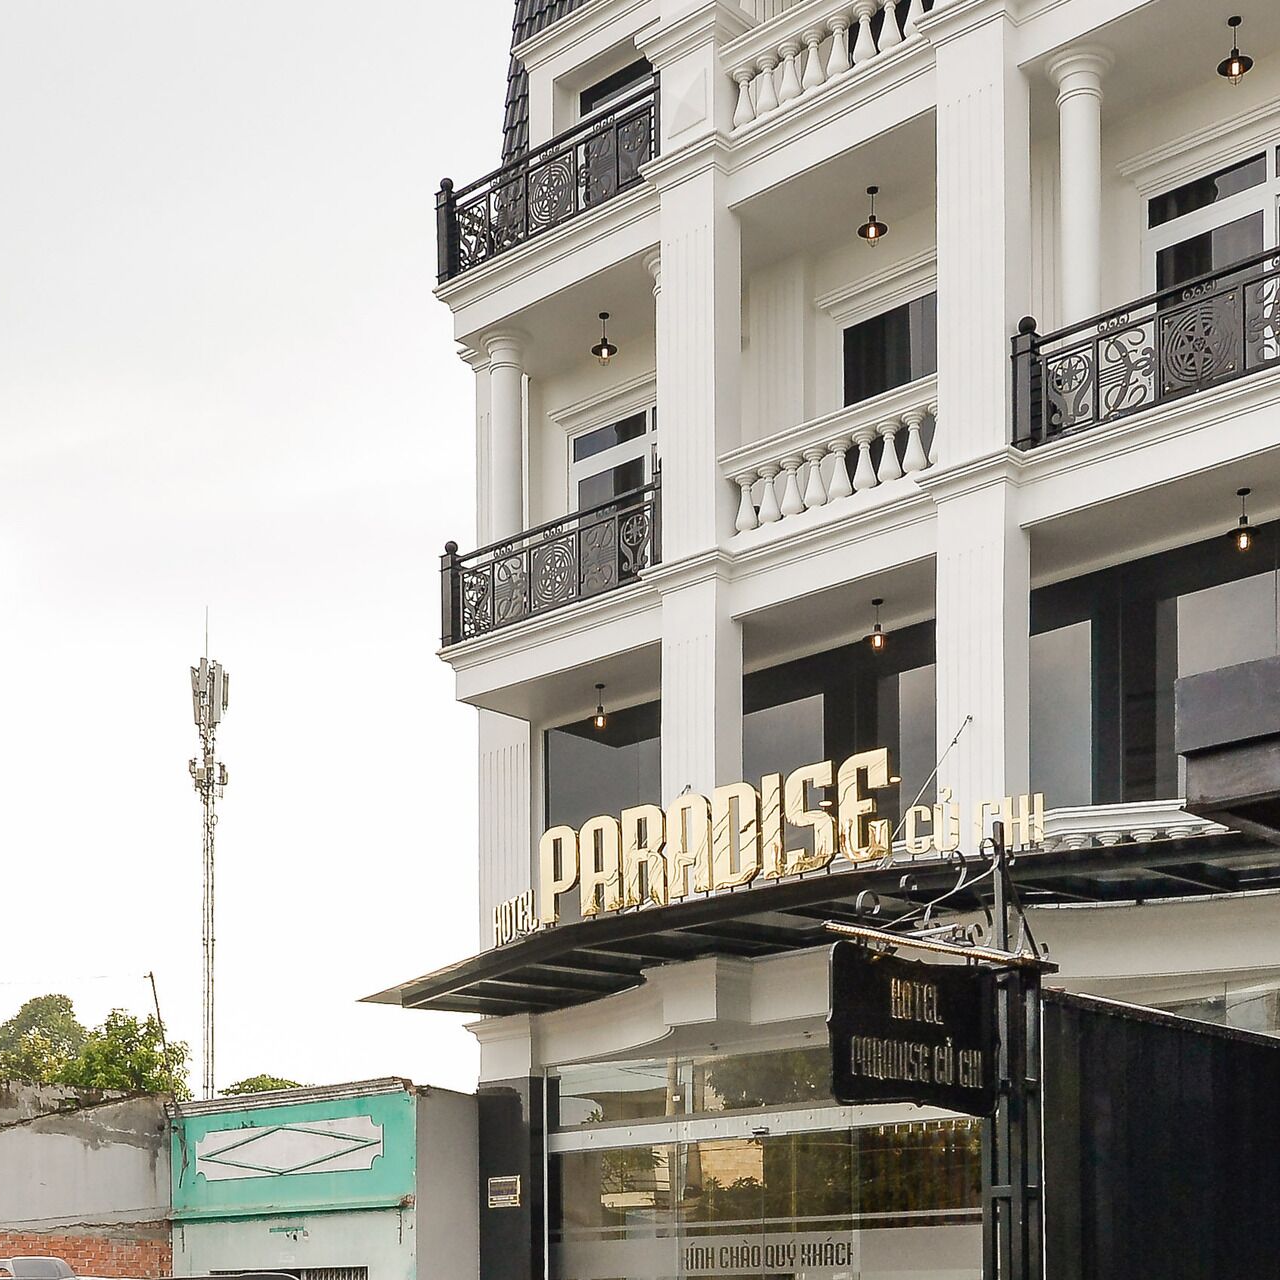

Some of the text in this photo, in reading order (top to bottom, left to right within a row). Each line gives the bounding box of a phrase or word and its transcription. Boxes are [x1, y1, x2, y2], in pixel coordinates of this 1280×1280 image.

[492, 747, 1045, 948] HOTEL PARADISE CỦ CHI
[891, 977, 944, 1025] HOTEL
[851, 1035, 930, 1083] PARADISE
[959, 1049, 984, 1089] CHI
[720, 1239, 761, 1269] CHÀO
[765, 1239, 796, 1268] QUÝ
